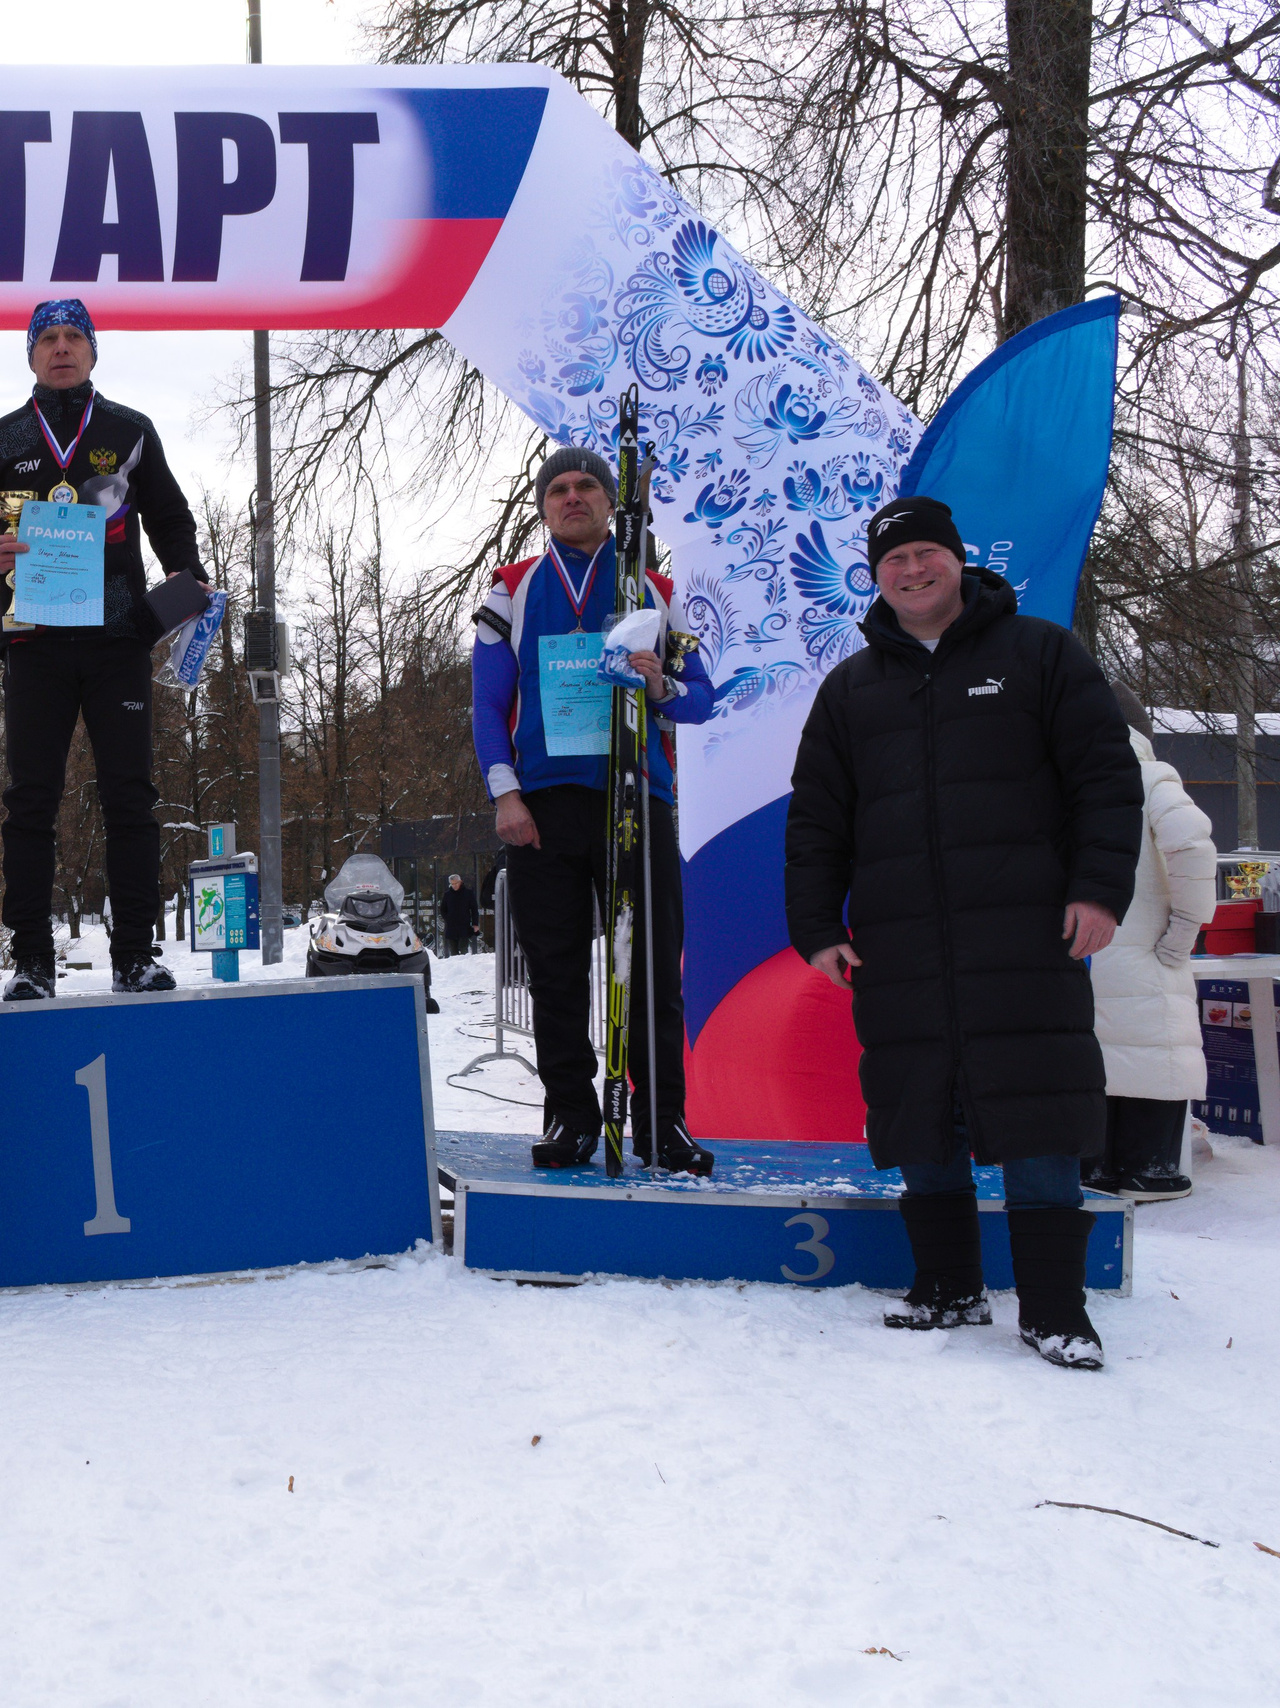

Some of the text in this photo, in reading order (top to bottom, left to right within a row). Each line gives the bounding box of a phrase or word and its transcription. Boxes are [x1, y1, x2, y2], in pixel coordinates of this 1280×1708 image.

[15, 459, 41, 474] RAY
[619, 450, 628, 504] FISCHER
[27, 526, 95, 542] ГРАМОТА
[548, 659, 599, 671] ГРАМО
[968, 685, 999, 697] PUMA
[122, 701, 144, 711] RAY
[611, 1082, 622, 1119] Vipsport
[75, 1052, 131, 1236] 1
[780, 1212, 835, 1282] 3
